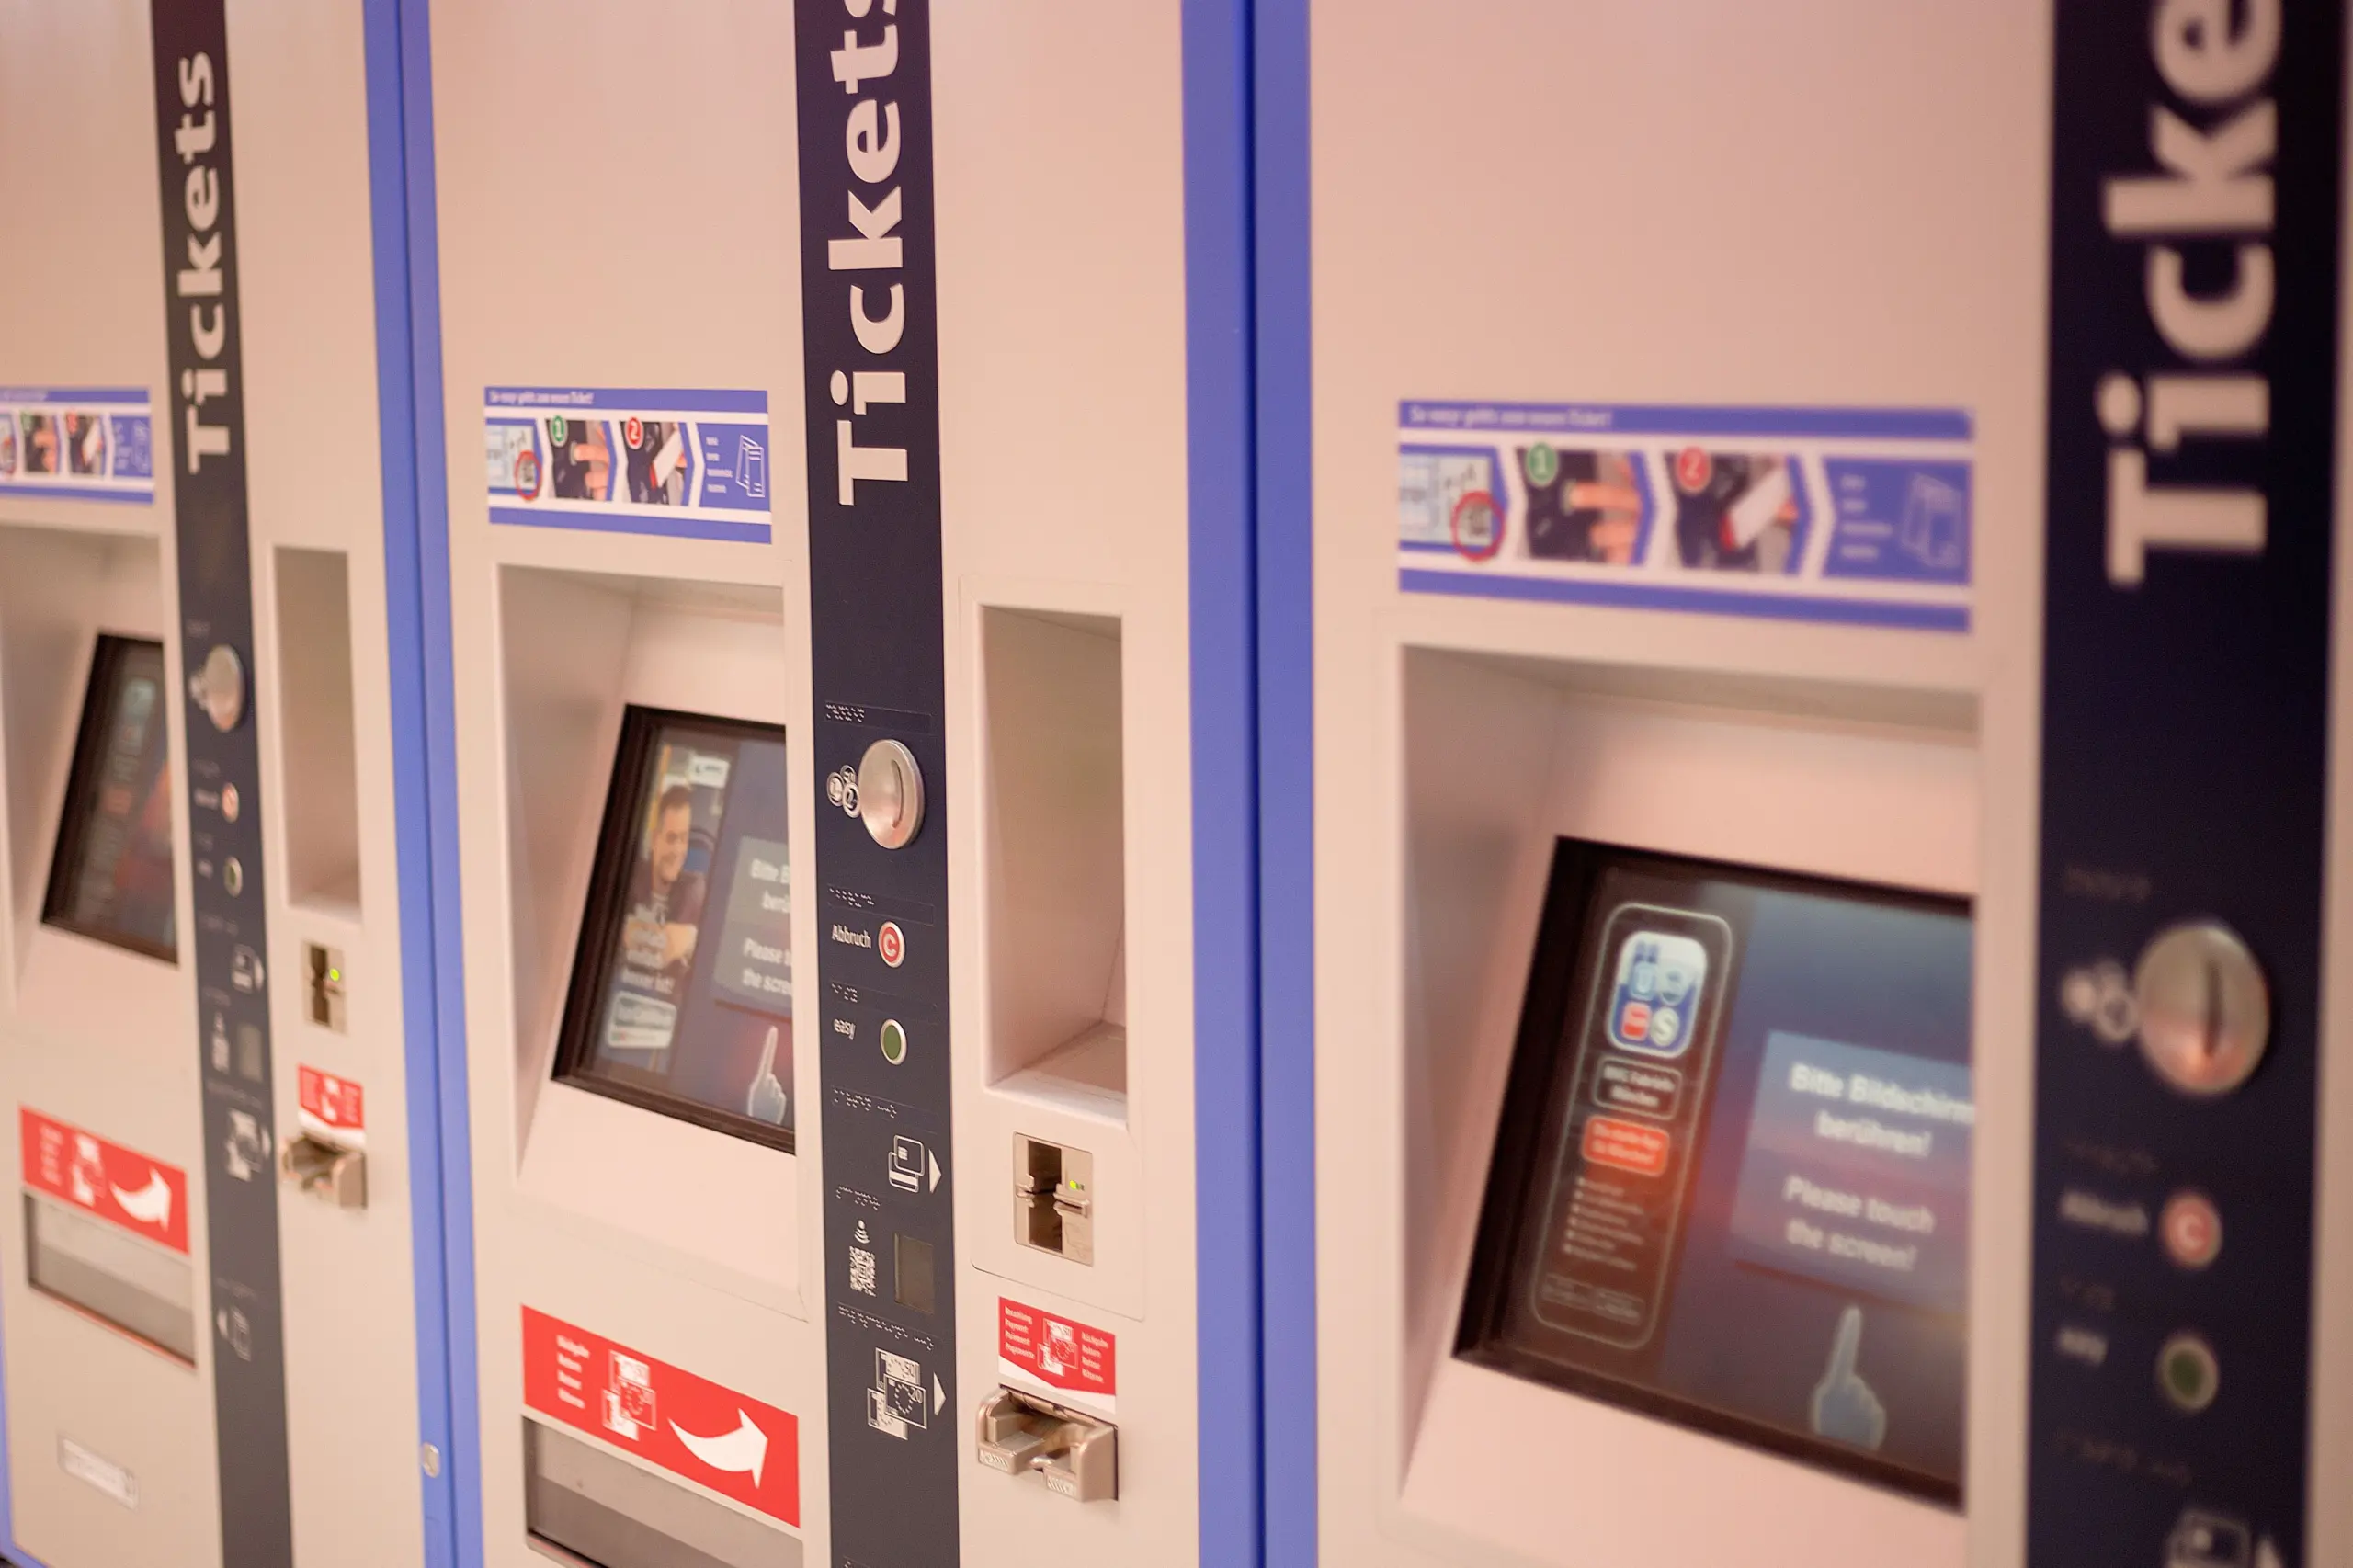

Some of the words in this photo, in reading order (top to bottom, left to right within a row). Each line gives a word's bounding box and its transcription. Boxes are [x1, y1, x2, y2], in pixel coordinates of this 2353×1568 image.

[175, 51, 231, 476] Tickets
[832, 924, 871, 949] Abbruch
[835, 1018, 856, 1040] easy
[1790, 1062, 1844, 1098] Bitte
[1814, 1108, 1933, 1158] berühren!
[1783, 1174, 1862, 1219] Please
[1865, 1197, 1935, 1234] touch
[1786, 1217, 1824, 1250] the
[1827, 1233, 1918, 1272] screen!
